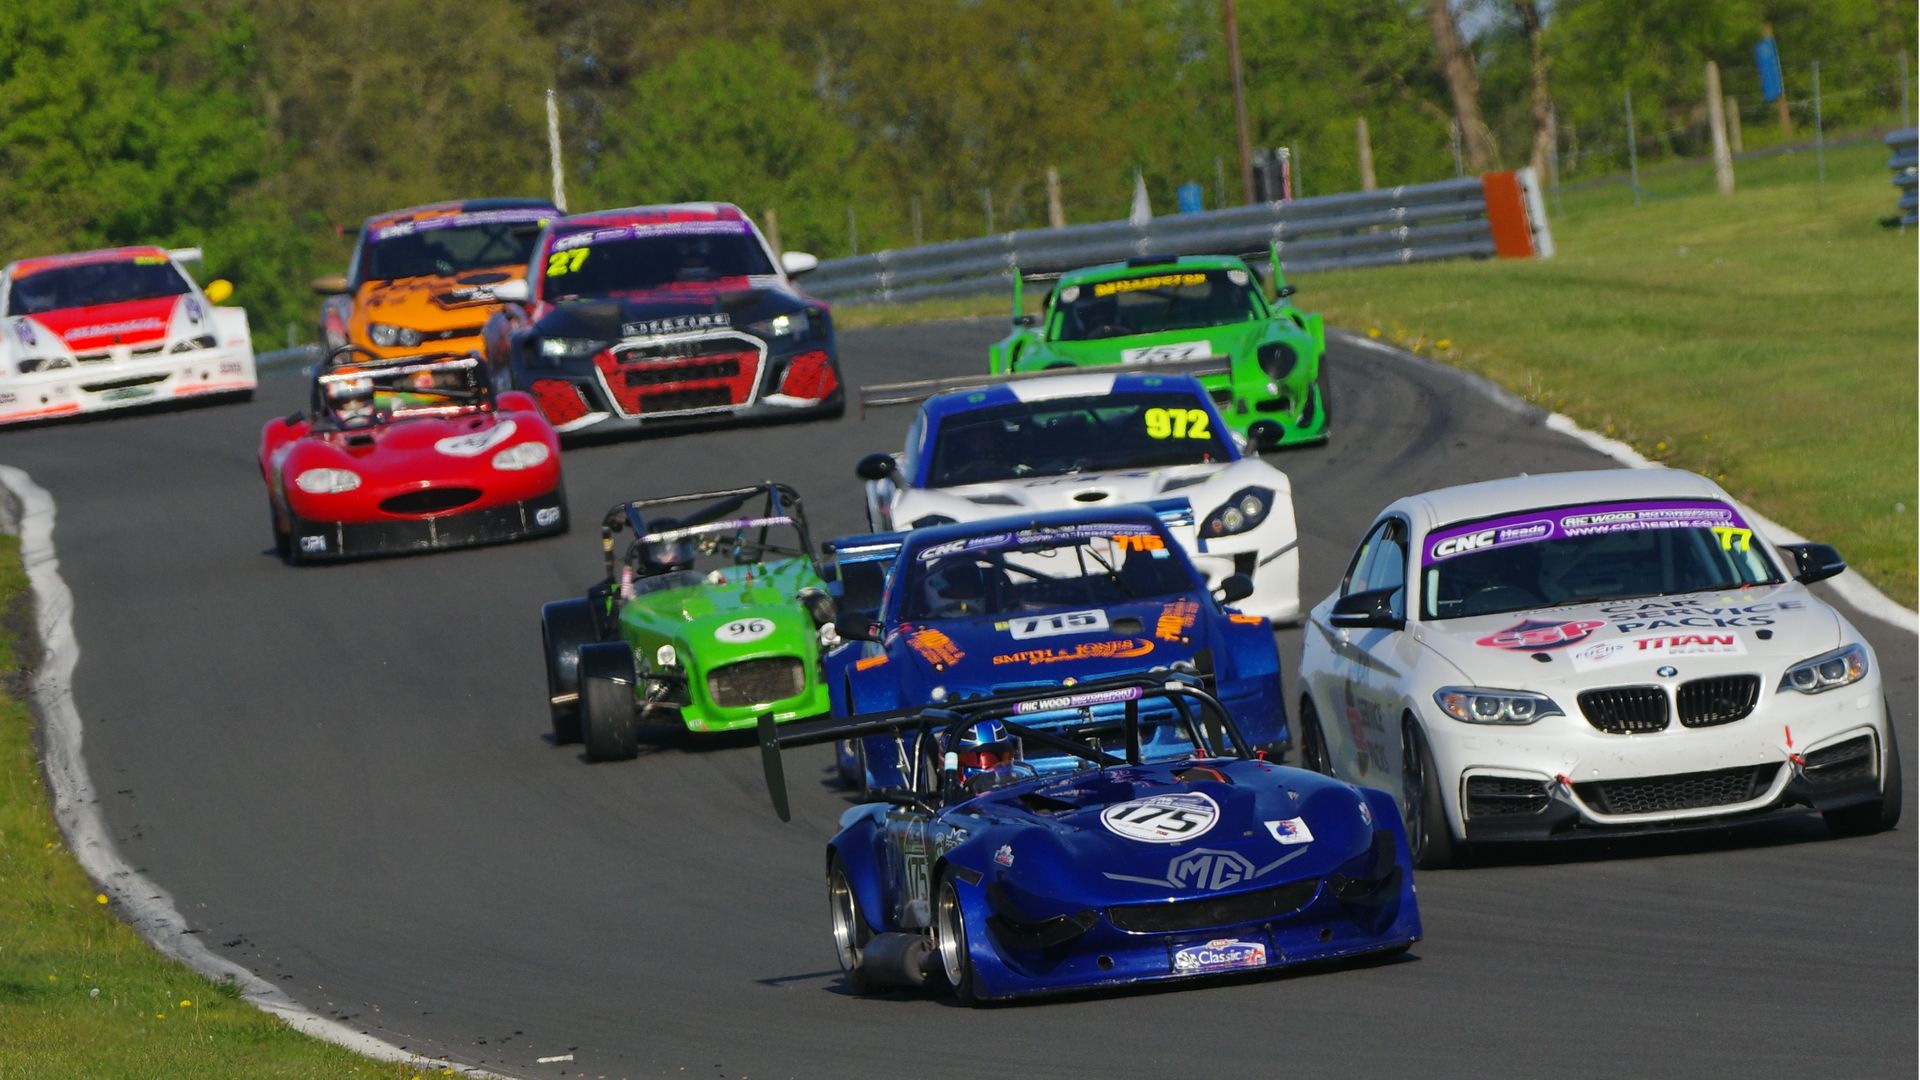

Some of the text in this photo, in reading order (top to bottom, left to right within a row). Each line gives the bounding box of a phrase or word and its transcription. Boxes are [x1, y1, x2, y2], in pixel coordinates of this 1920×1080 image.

[547, 248, 590, 277] 27
[1144, 408, 1212, 440] 972
[1564, 519, 1736, 537] www.cncheads.co.uk
[1565, 509, 1724, 527] RIC WOOD MOTORSPORT
[1112, 534, 1165, 551] 715
[1437, 524, 1546, 556] CNC Heads
[1711, 526, 1752, 551] 77
[920, 540, 966, 560] CNC
[1601, 600, 1703, 613] CAR
[1608, 600, 1806, 622] SERVICE
[729, 620, 765, 636] 96
[1021, 612, 1098, 634] 715
[1617, 615, 1776, 633] PACKS
[993, 649, 1053, 665] SMITH
[1075, 640, 1134, 656] JONES
[1633, 634, 1734, 650] TITAN
[1021, 701, 1038, 712] RIC
[1039, 697, 1071, 709] WOOD
[1071, 688, 1132, 704] MOTORSPORT
[1110, 805, 1210, 833] 175
[1177, 855, 1243, 890] MG
[1199, 950, 1242, 964] Classic
